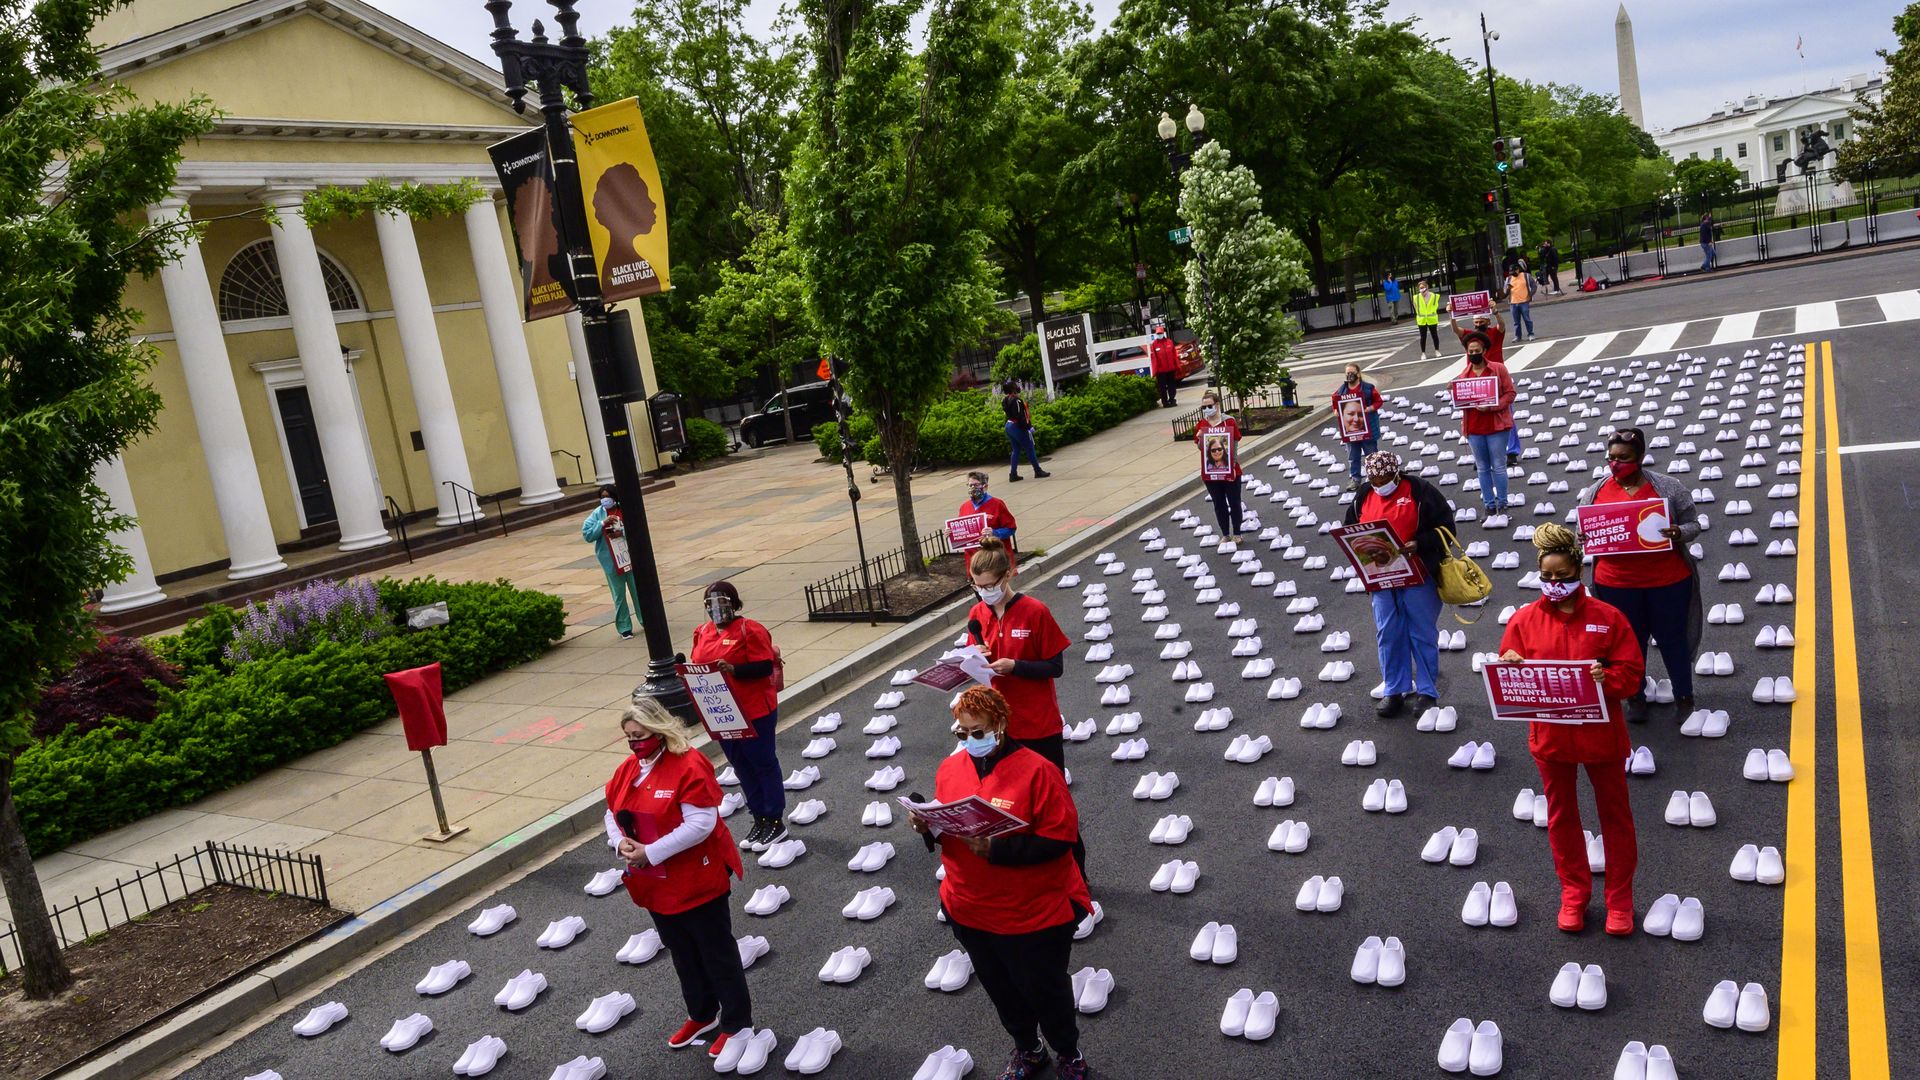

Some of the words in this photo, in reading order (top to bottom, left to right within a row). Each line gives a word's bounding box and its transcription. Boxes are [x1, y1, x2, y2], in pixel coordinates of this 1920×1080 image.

[594, 124, 629, 141] DOWNTOWN
[511, 152, 540, 170] DOWNTOWN
[1175, 231, 1181, 239] H
[612, 263, 632, 276] BLACK
[632, 259, 649, 271] LIVES
[611, 273, 635, 286] MATTER
[635, 268, 655, 280] PLAZA
[531, 284, 547, 297] BLACK
[547, 281, 562, 292] LIVES
[531, 293, 550, 305] MATTER
[550, 289, 567, 300] PLAZA
[1453, 293, 1484, 303] PROTECT
[1046, 328, 1065, 340] BLACK
[1065, 324, 1081, 336] LIVES
[1054, 337, 1077, 351] MATTER
[1455, 379, 1491, 388] PROTECT
[950, 516, 980, 529] PROTECT
[1583, 516, 1598, 525] PPE
[1599, 514, 1606, 522] IS
[1583, 515, 1630, 531] DISPOSABLE
[1344, 522, 1375, 534] NNU
[1585, 524, 1626, 539] NURSES
[1586, 536, 1608, 548] ARE
[1609, 531, 1631, 543] NOT
[686, 665, 710, 674] NNU
[1496, 667, 1583, 679] PROTECT
[696, 675, 709, 686] 15
[1500, 681, 1537, 689] NURSES
[1501, 688, 1547, 696] PATIENTS
[703, 694, 722, 705] 403
[1503, 695, 1537, 703] PUBLIC
[706, 704, 732, 714] NURSES
[714, 714, 735, 724] DEAD
